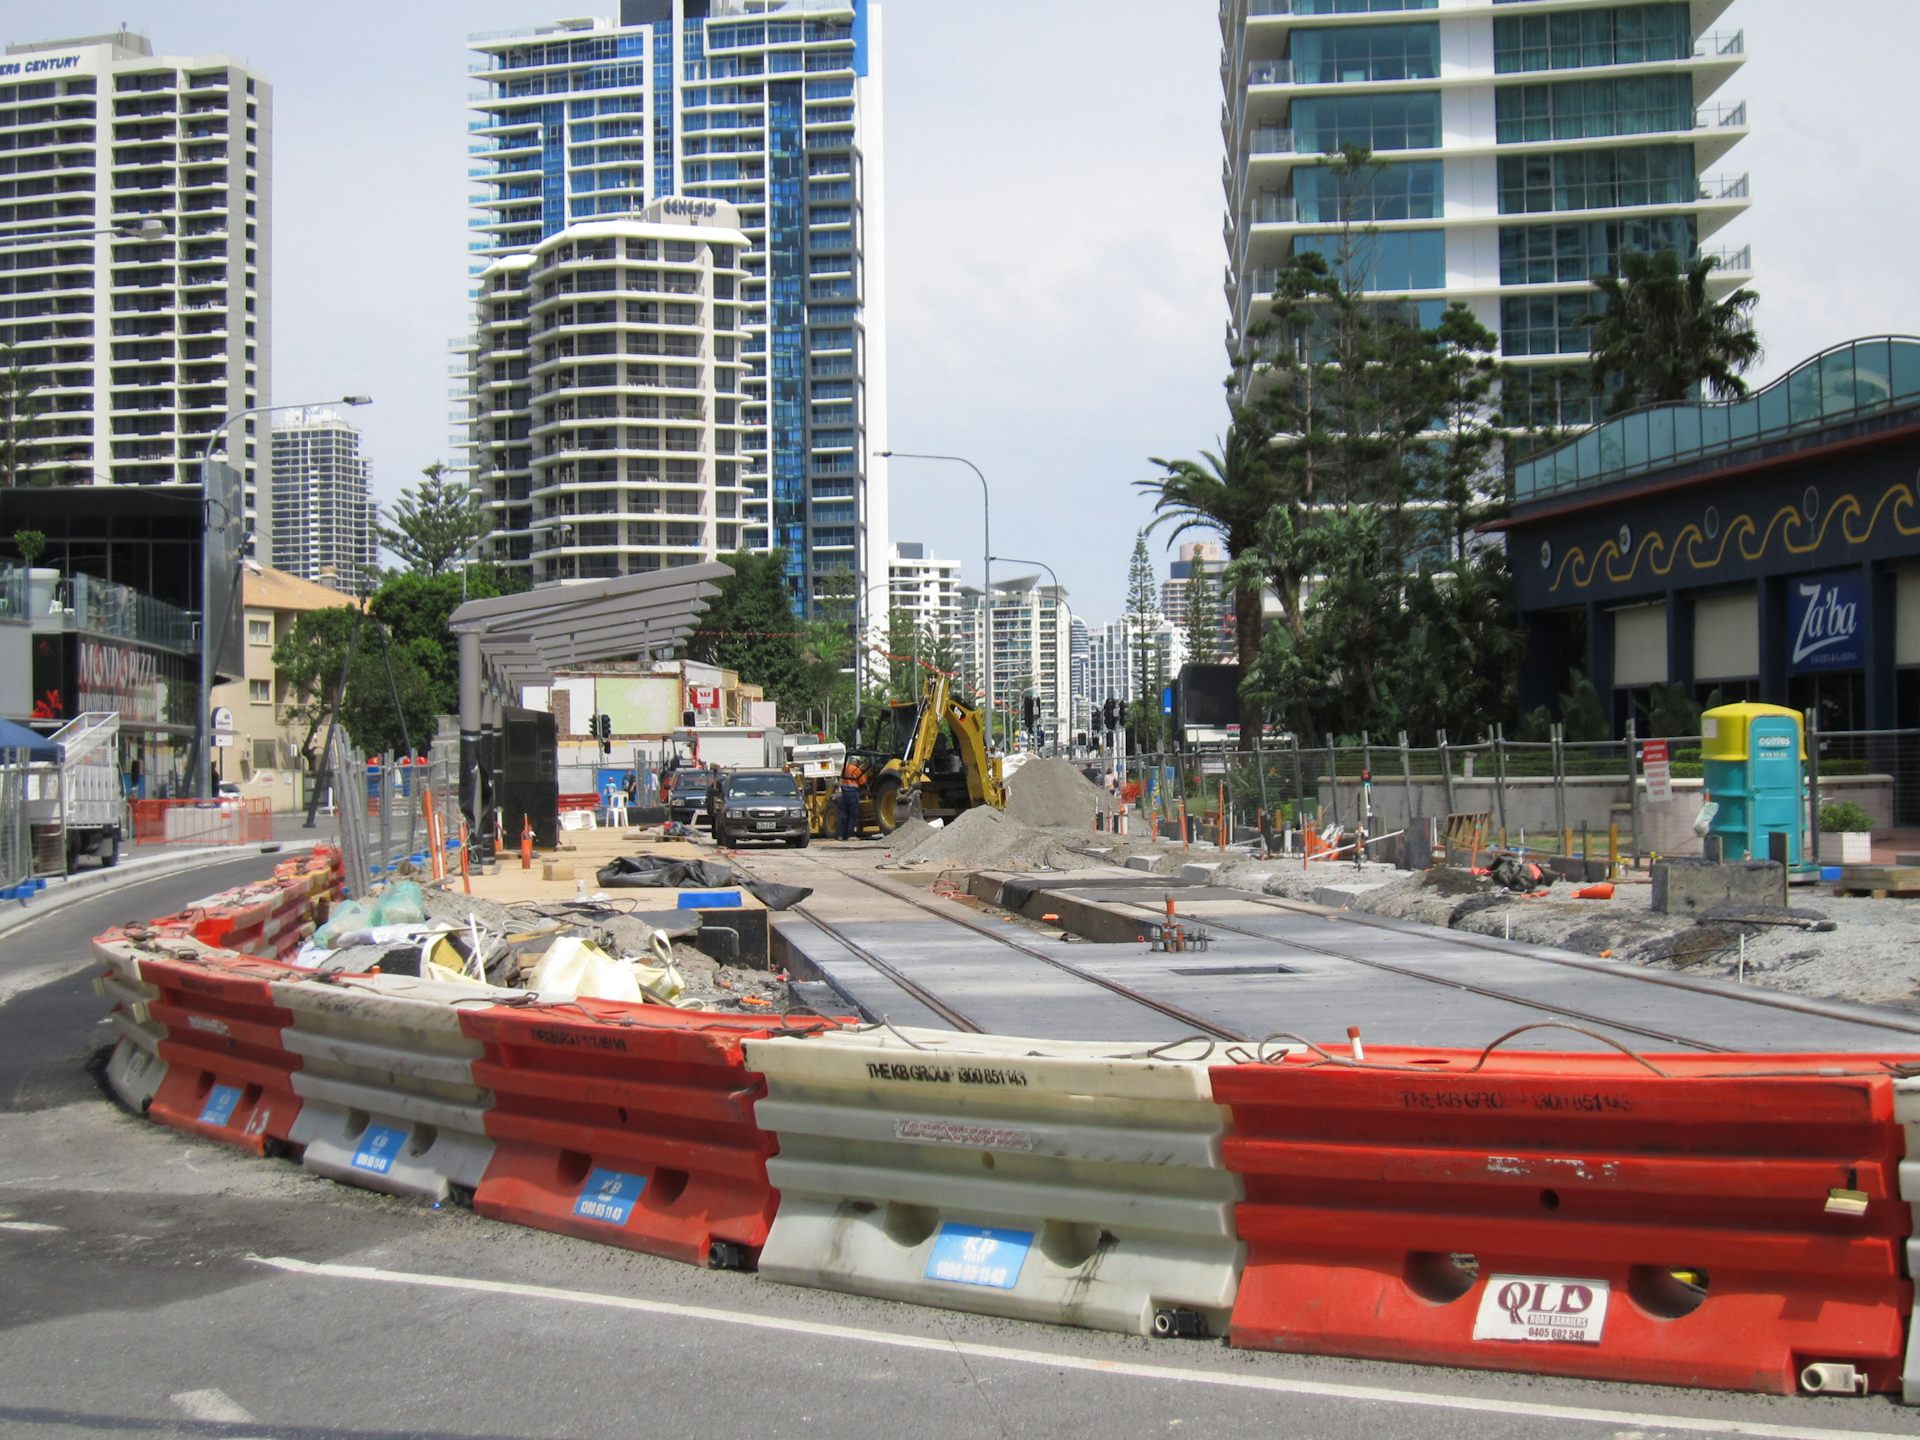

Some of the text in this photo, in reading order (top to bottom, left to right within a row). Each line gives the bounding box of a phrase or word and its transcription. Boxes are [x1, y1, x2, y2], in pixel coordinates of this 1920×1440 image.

[25, 55, 80, 73] CENTURY
[663, 198, 717, 217] GENESIS
[1793, 583, 1857, 664] Za'ba
[866, 1063, 892, 1080] THE
[891, 1064, 909, 1081] KB
[984, 1069, 1005, 1085] 851
[601, 1180, 623, 1195] KB
[962, 1237, 998, 1254] KB
[1497, 1281, 1593, 1325] QLD
[1529, 1314, 1588, 1328] ROAD BARRIERS
[1528, 1327, 1585, 1341] 0405 602 548
